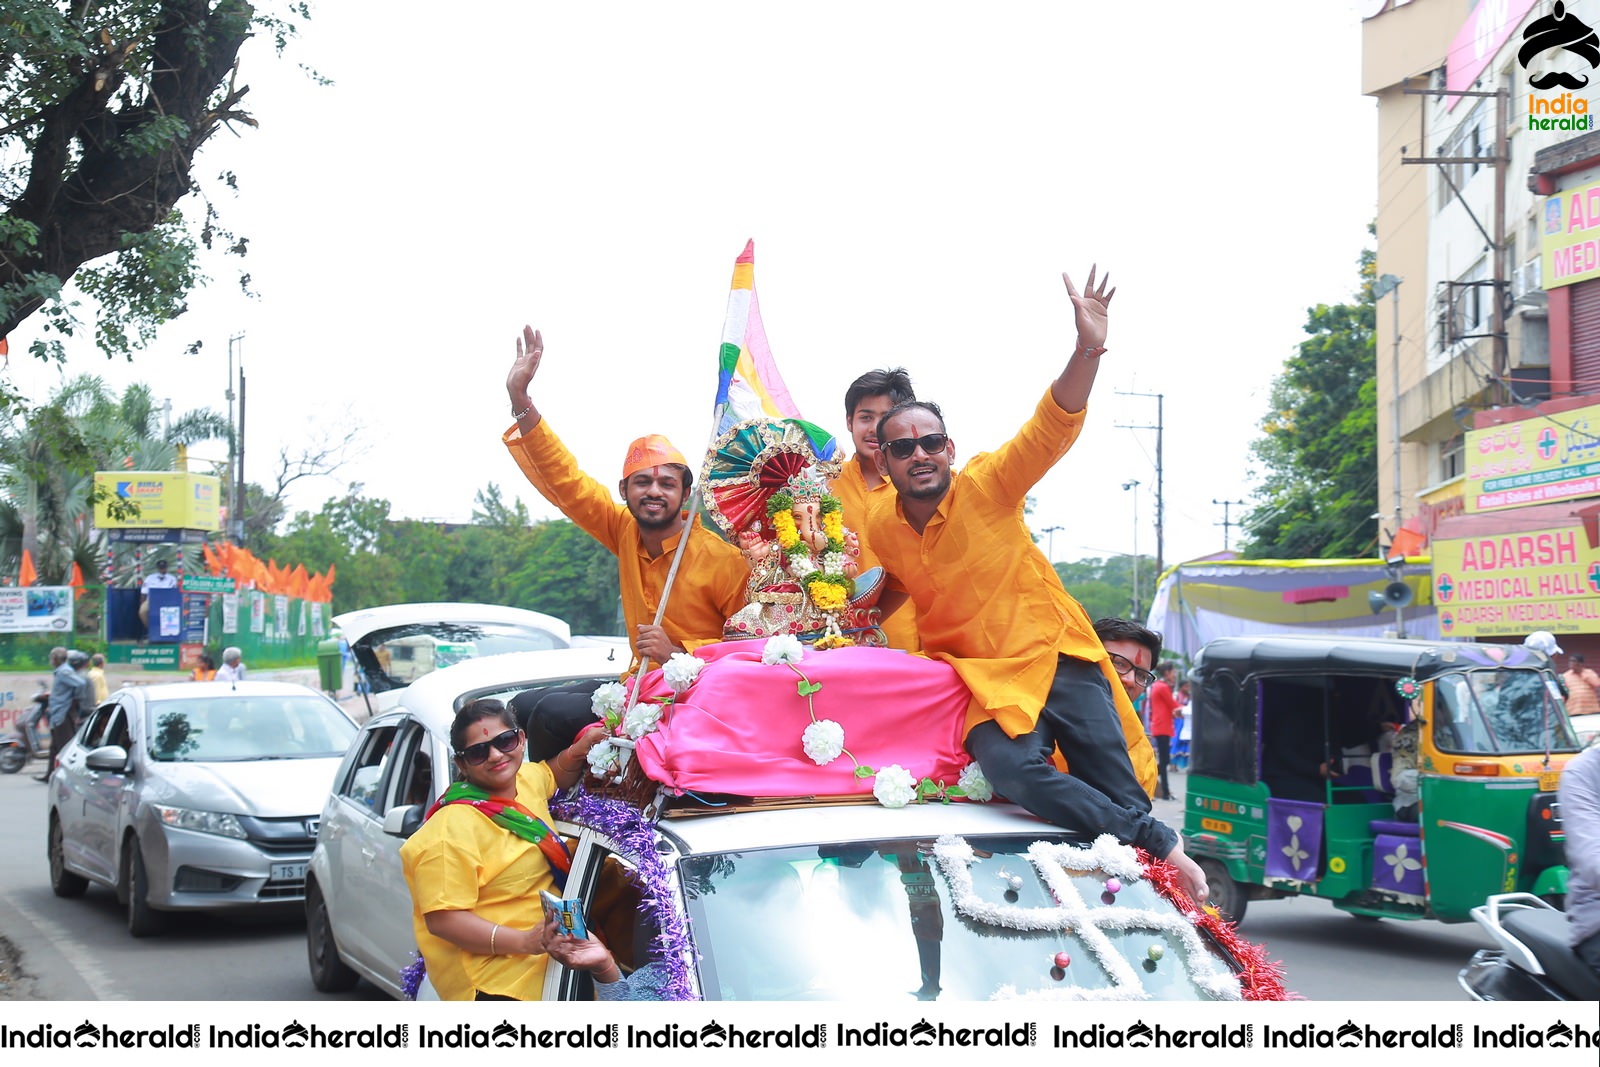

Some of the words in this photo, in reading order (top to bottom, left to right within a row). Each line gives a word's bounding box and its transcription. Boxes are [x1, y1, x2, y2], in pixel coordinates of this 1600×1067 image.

[1506, 491, 1532, 504] Sales
[1545, 481, 1595, 498] Wholesale
[1462, 531, 1576, 572] ADARSH
[1458, 577, 1534, 600] MEDICAL
[1538, 573, 1586, 597] HALL
[1457, 606, 1504, 624] ADARSH
[1507, 603, 1563, 622] MEDICAL
[1566, 602, 1600, 620] HALL
[281, 865, 294, 878] TS
